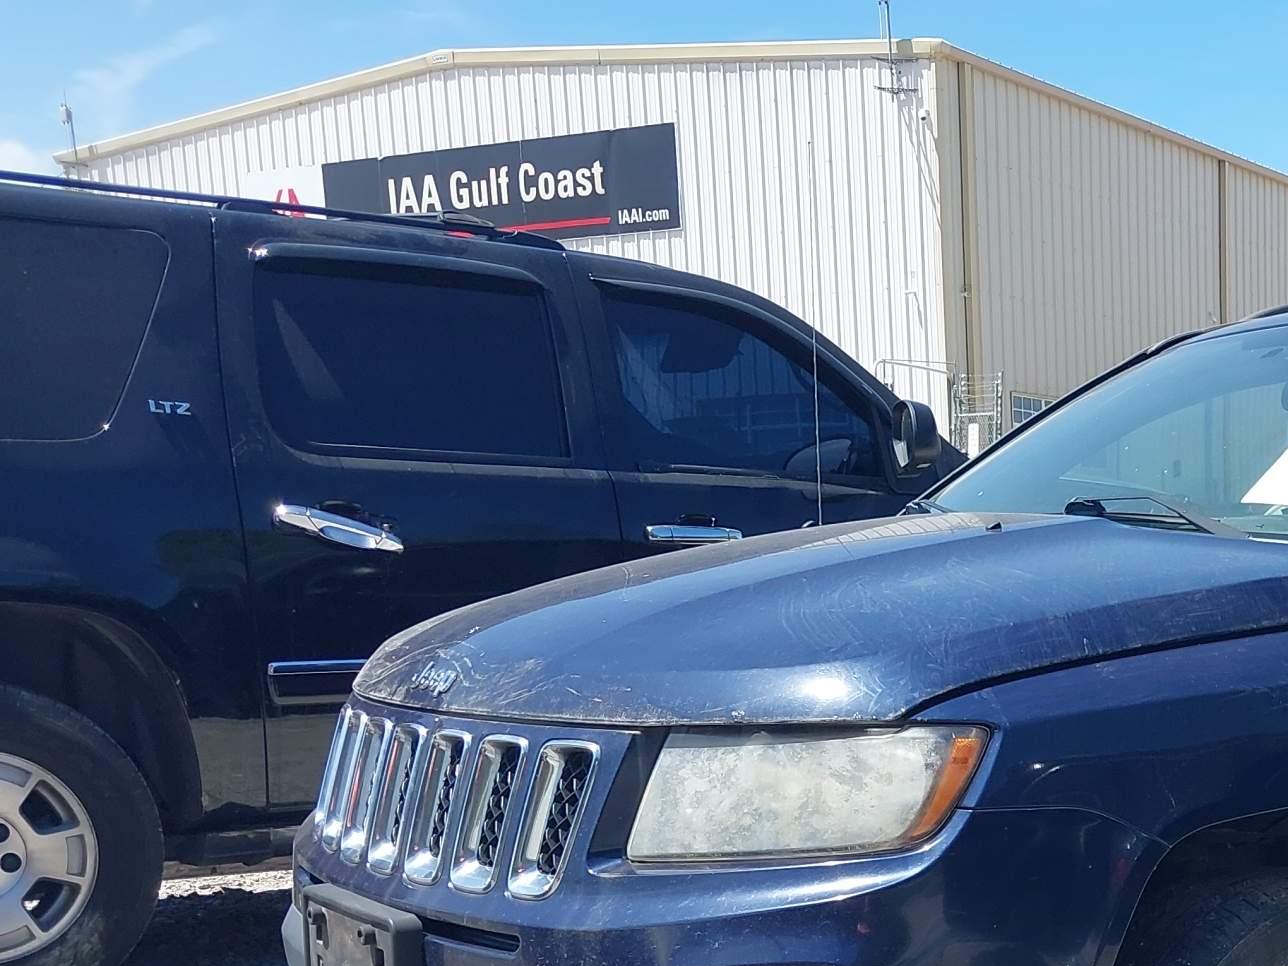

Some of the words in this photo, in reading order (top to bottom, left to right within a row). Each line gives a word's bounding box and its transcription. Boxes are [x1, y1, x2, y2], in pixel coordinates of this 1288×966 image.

[388, 174, 442, 214] IAA
[450, 166, 509, 210] Gulf
[518, 160, 605, 203] Coast
[618, 207, 670, 225] IAAI.com
[148, 399, 192, 416] LTZ
